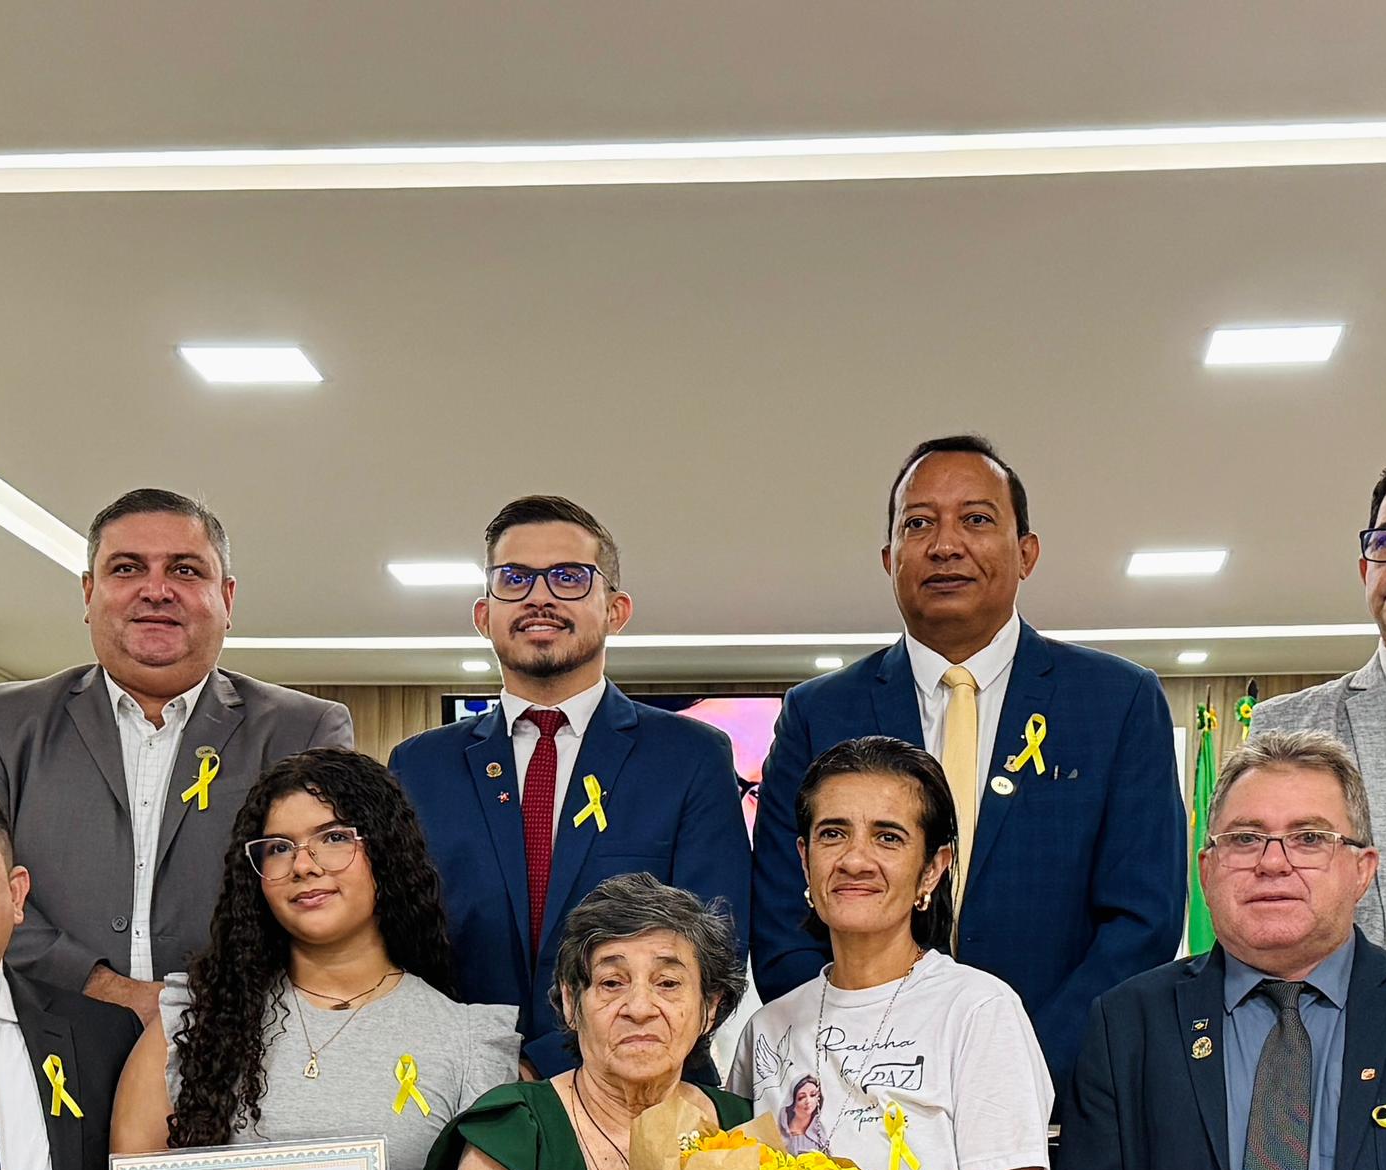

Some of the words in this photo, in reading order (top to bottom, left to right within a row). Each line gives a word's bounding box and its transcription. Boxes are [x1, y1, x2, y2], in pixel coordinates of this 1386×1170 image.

[815, 1025, 916, 1062] Rainha
[869, 1069, 915, 1087] PAZ
[858, 1115, 884, 1132] por
